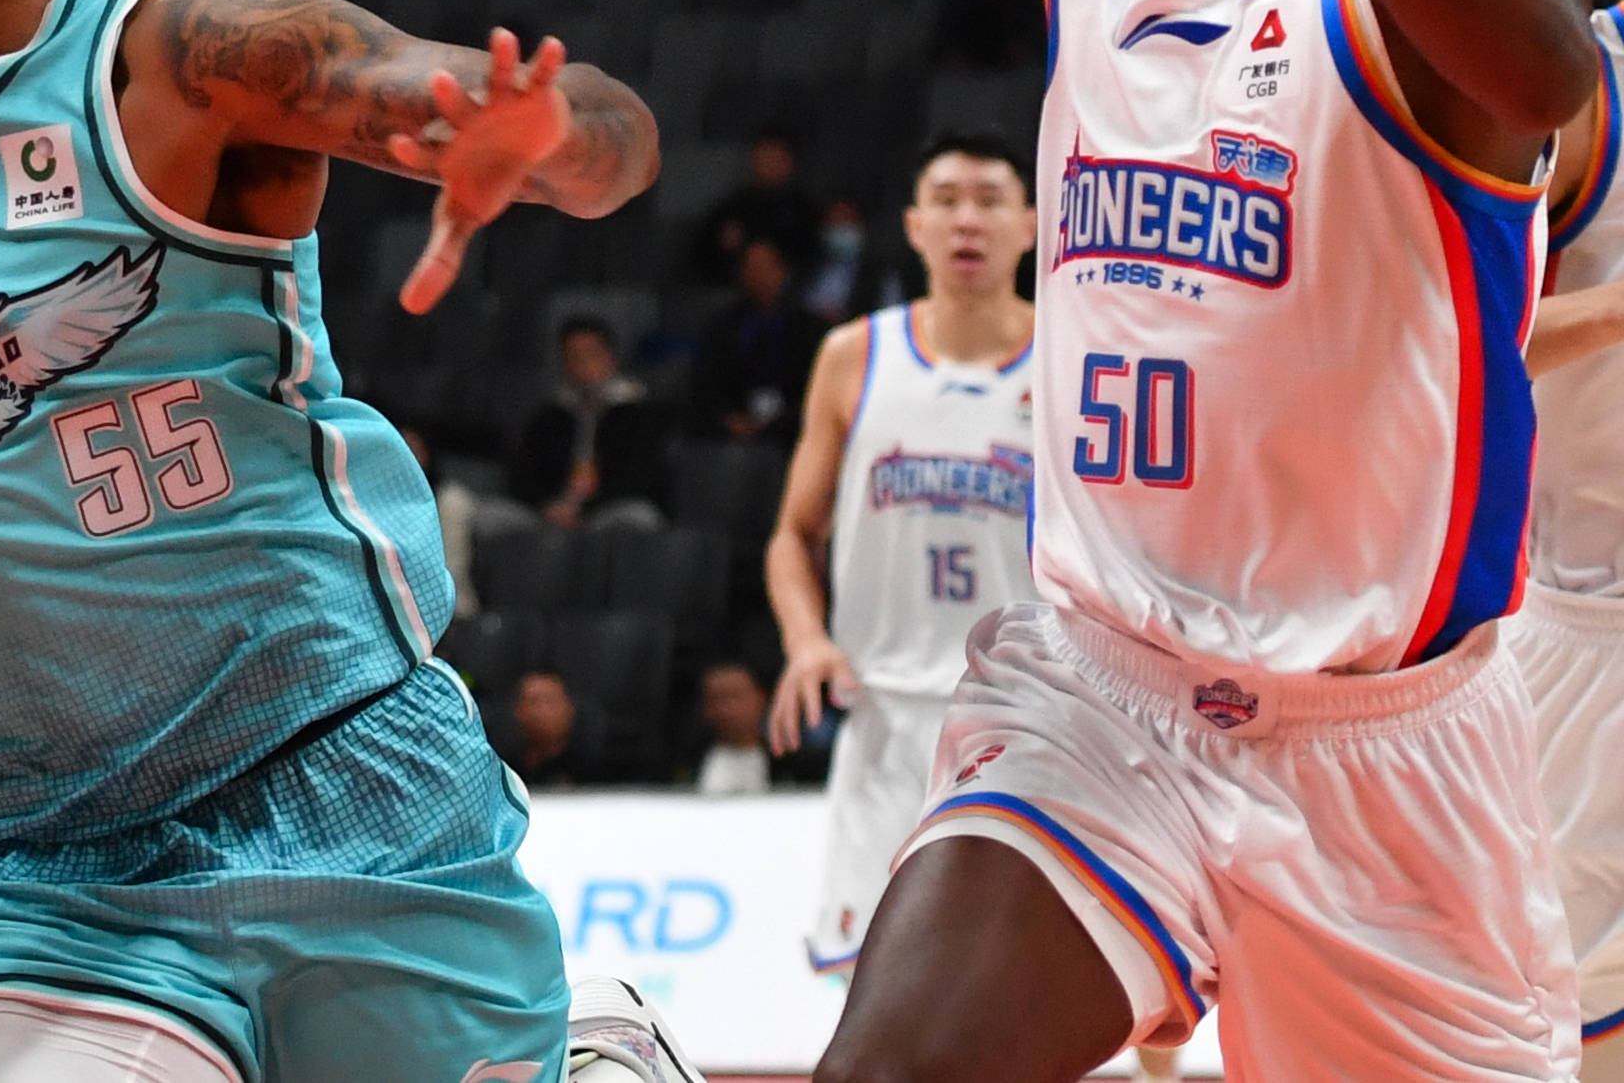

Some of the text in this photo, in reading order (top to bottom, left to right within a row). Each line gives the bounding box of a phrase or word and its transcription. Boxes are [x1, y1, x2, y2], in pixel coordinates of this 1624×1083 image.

[1246, 80, 1278, 99] CGB
[14, 202, 75, 219] CHINA LIFE
[15, 185, 75, 209] 中国人寿
[1056, 168, 1282, 279] PIONEERS
[1103, 262, 1164, 289] 1895
[1073, 352, 1195, 490] 50
[51, 378, 233, 538] 55
[928, 545, 978, 601] 15
[564, 878, 734, 953] RD
